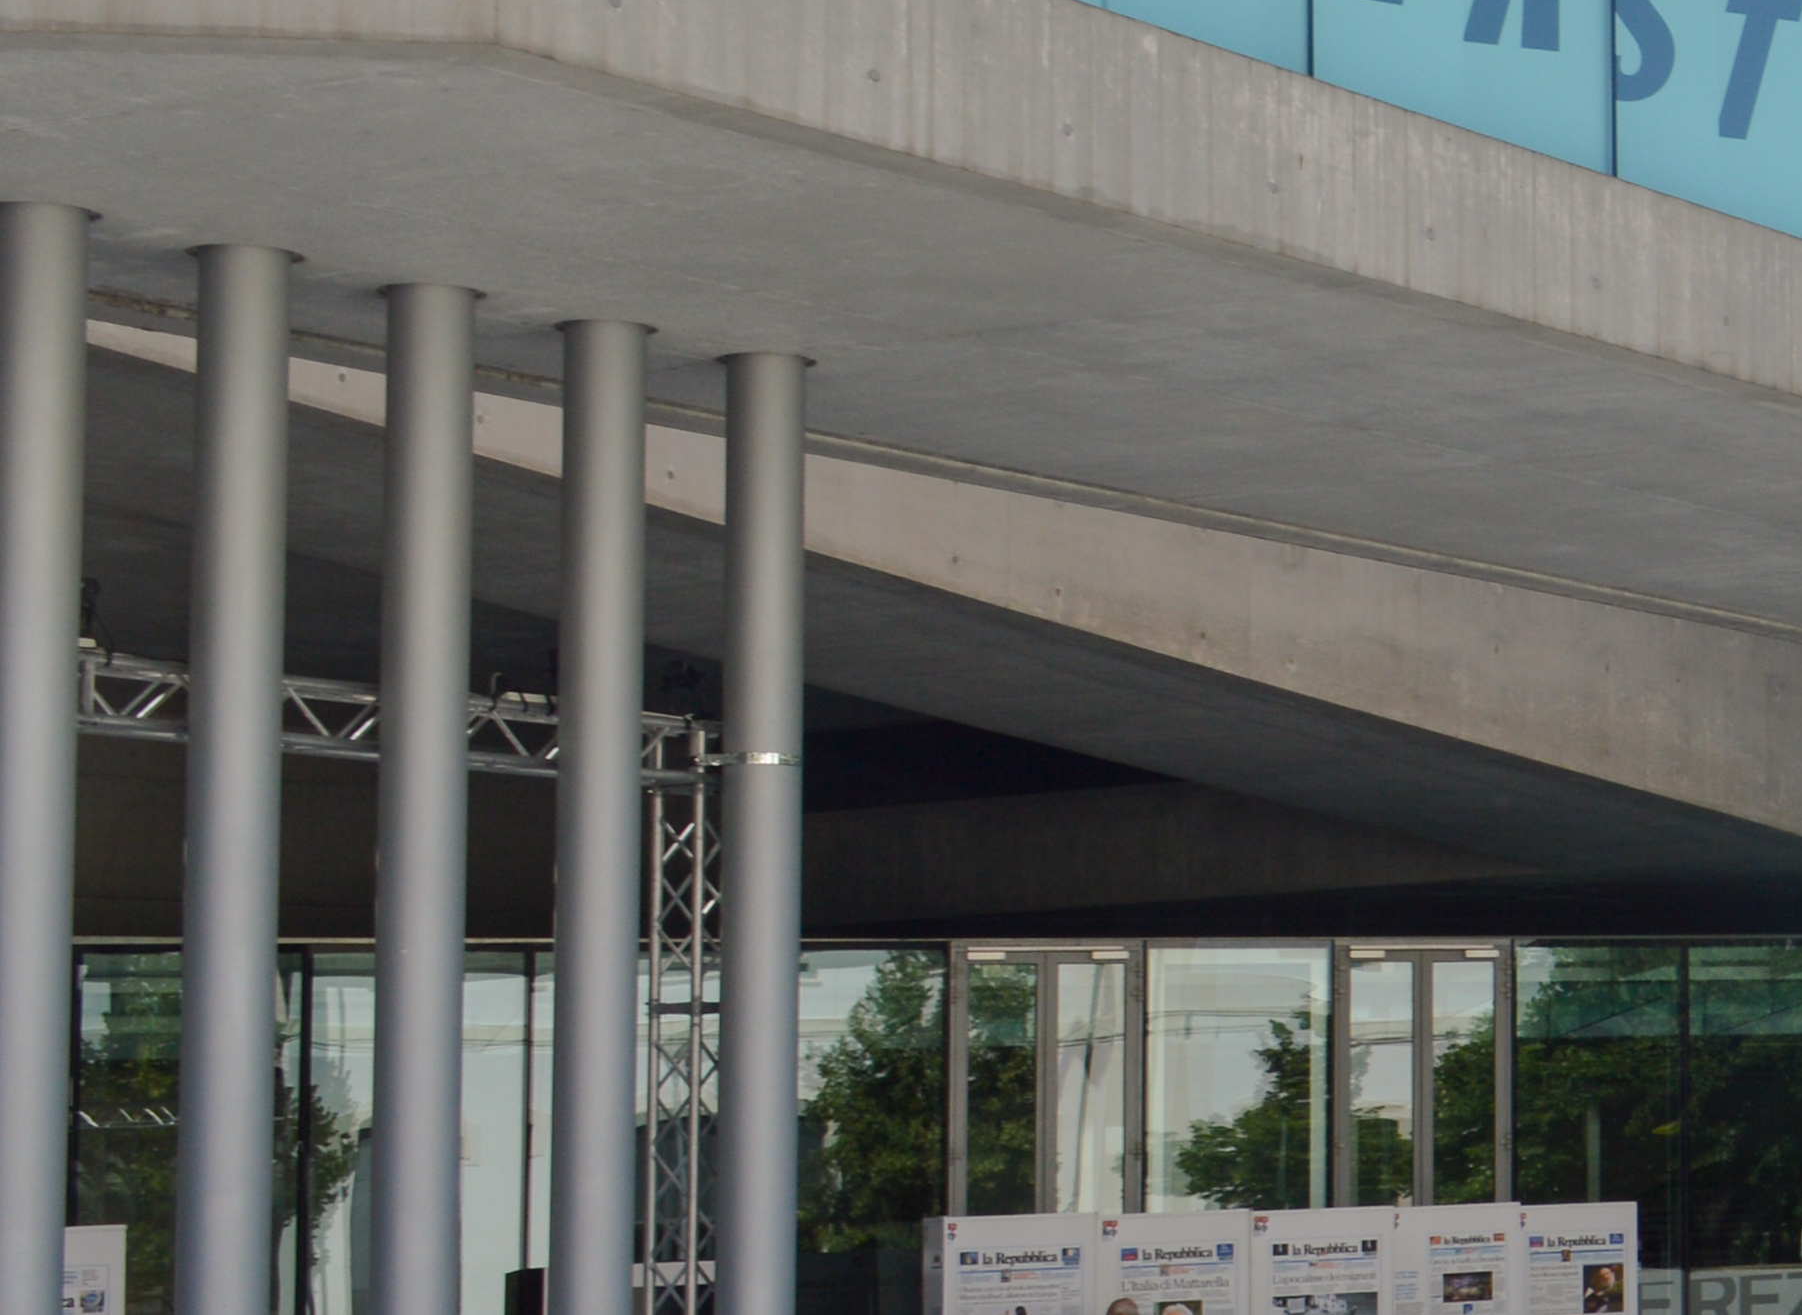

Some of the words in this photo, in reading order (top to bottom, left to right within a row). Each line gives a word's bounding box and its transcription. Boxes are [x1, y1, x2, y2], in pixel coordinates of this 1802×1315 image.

[1547, 1237, 1555, 1247] la
[1558, 1235, 1606, 1248] Repubblica
[1142, 1249, 1152, 1261] la
[1155, 1246, 1213, 1261] Repubblica
[1292, 1245, 1302, 1255] la
[1304, 1242, 1358, 1256] Repubblica
[982, 1253, 992, 1264] la
[996, 1250, 1057, 1265] Repubblica
